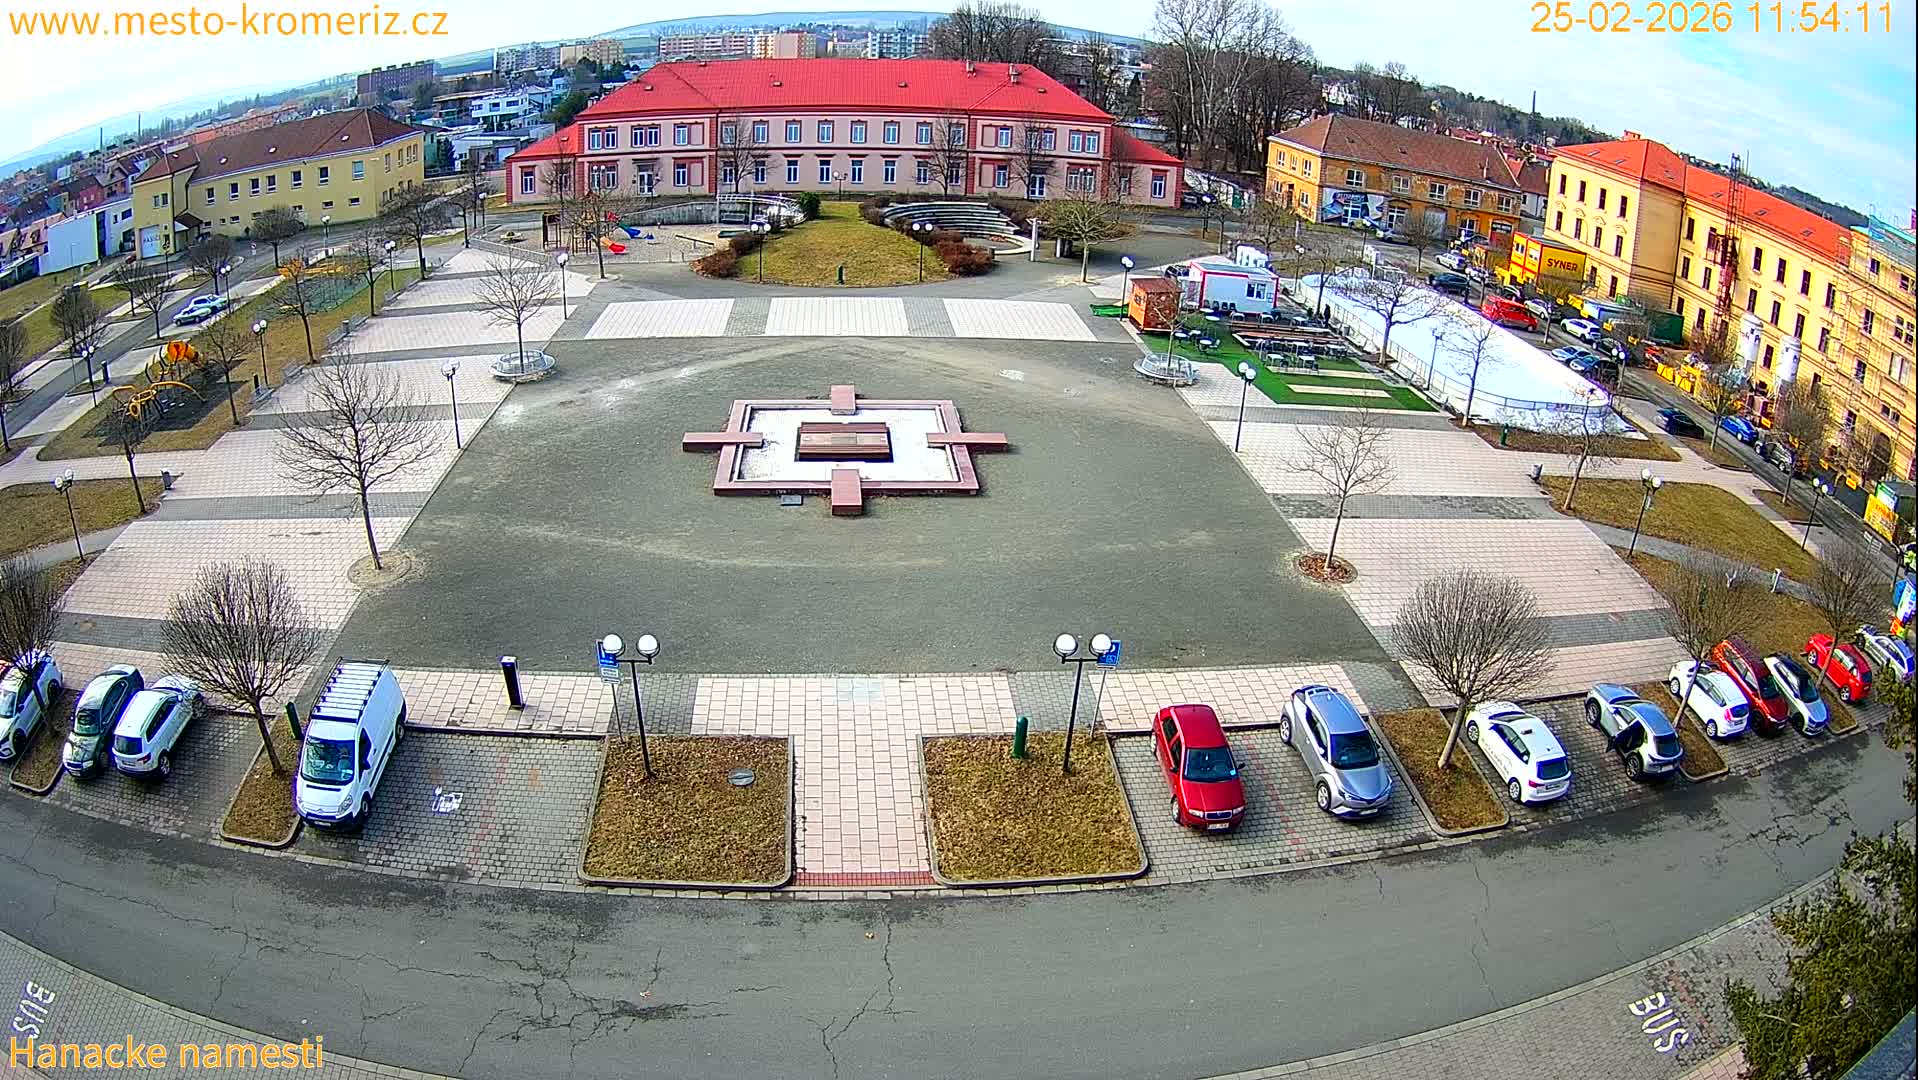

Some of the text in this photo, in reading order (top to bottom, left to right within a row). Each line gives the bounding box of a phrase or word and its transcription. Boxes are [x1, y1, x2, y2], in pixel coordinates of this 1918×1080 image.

[1547, 258, 1578, 271] SYNER
[13, 981, 56, 1039] BUS
[1628, 991, 1689, 1052] BUS
